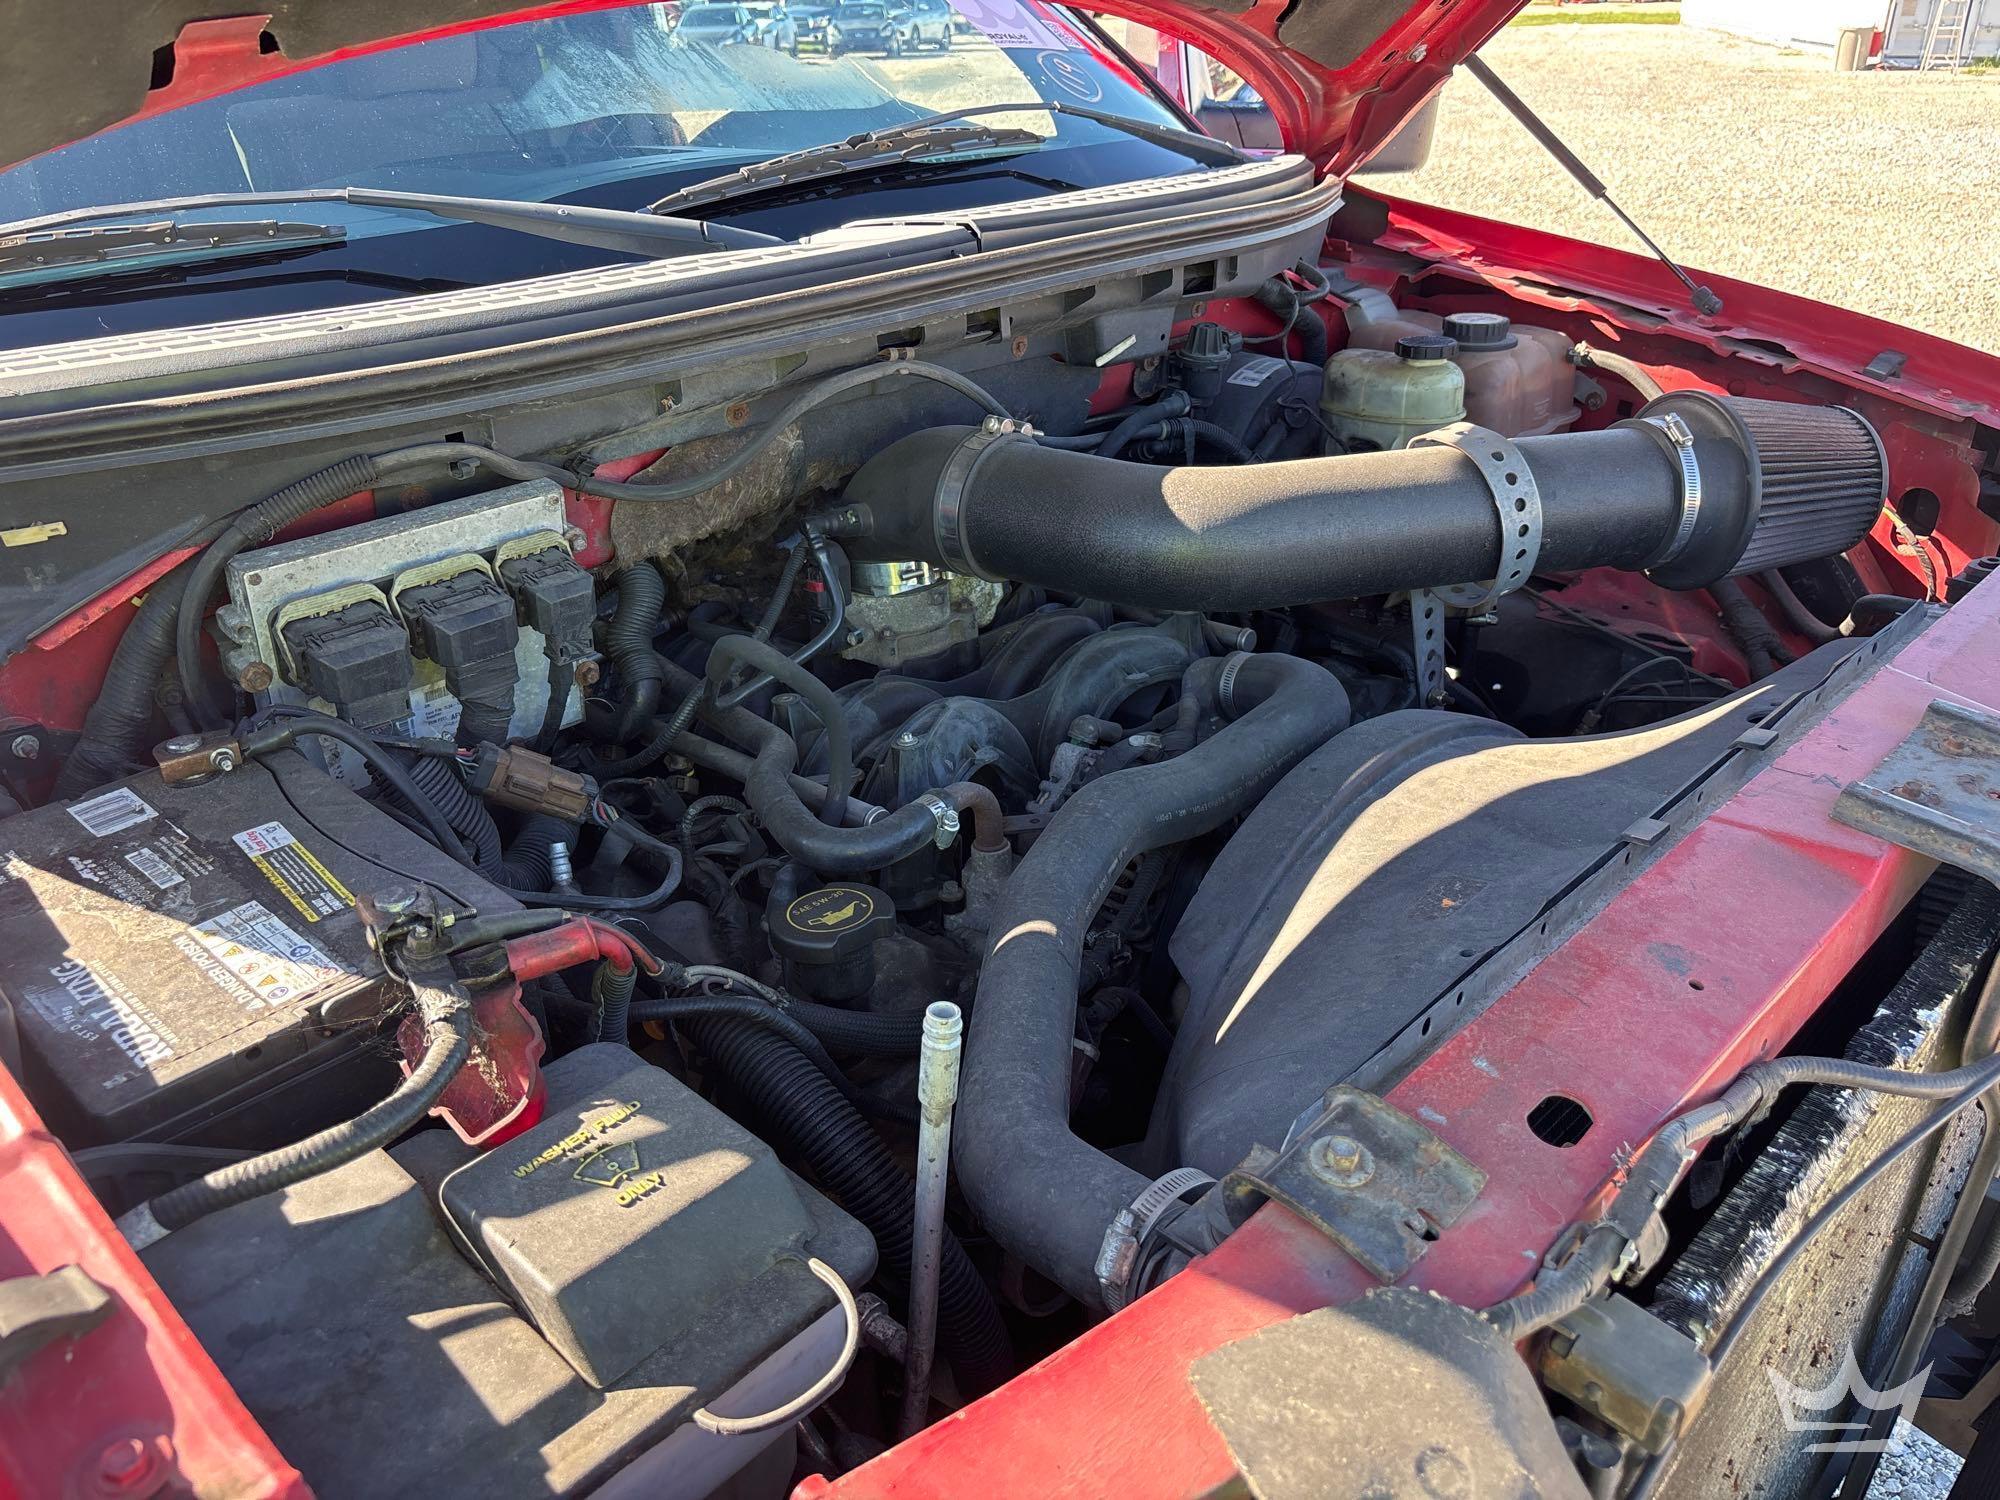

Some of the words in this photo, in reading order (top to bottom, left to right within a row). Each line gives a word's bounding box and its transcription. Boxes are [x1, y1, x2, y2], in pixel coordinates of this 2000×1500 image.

[49, 957, 116, 1007] KING
[90, 996, 175, 1069] RURAL
[512, 1129, 593, 1179] WASHER
[592, 1100, 642, 1132] FLUID
[615, 1171, 662, 1206] ONLY
